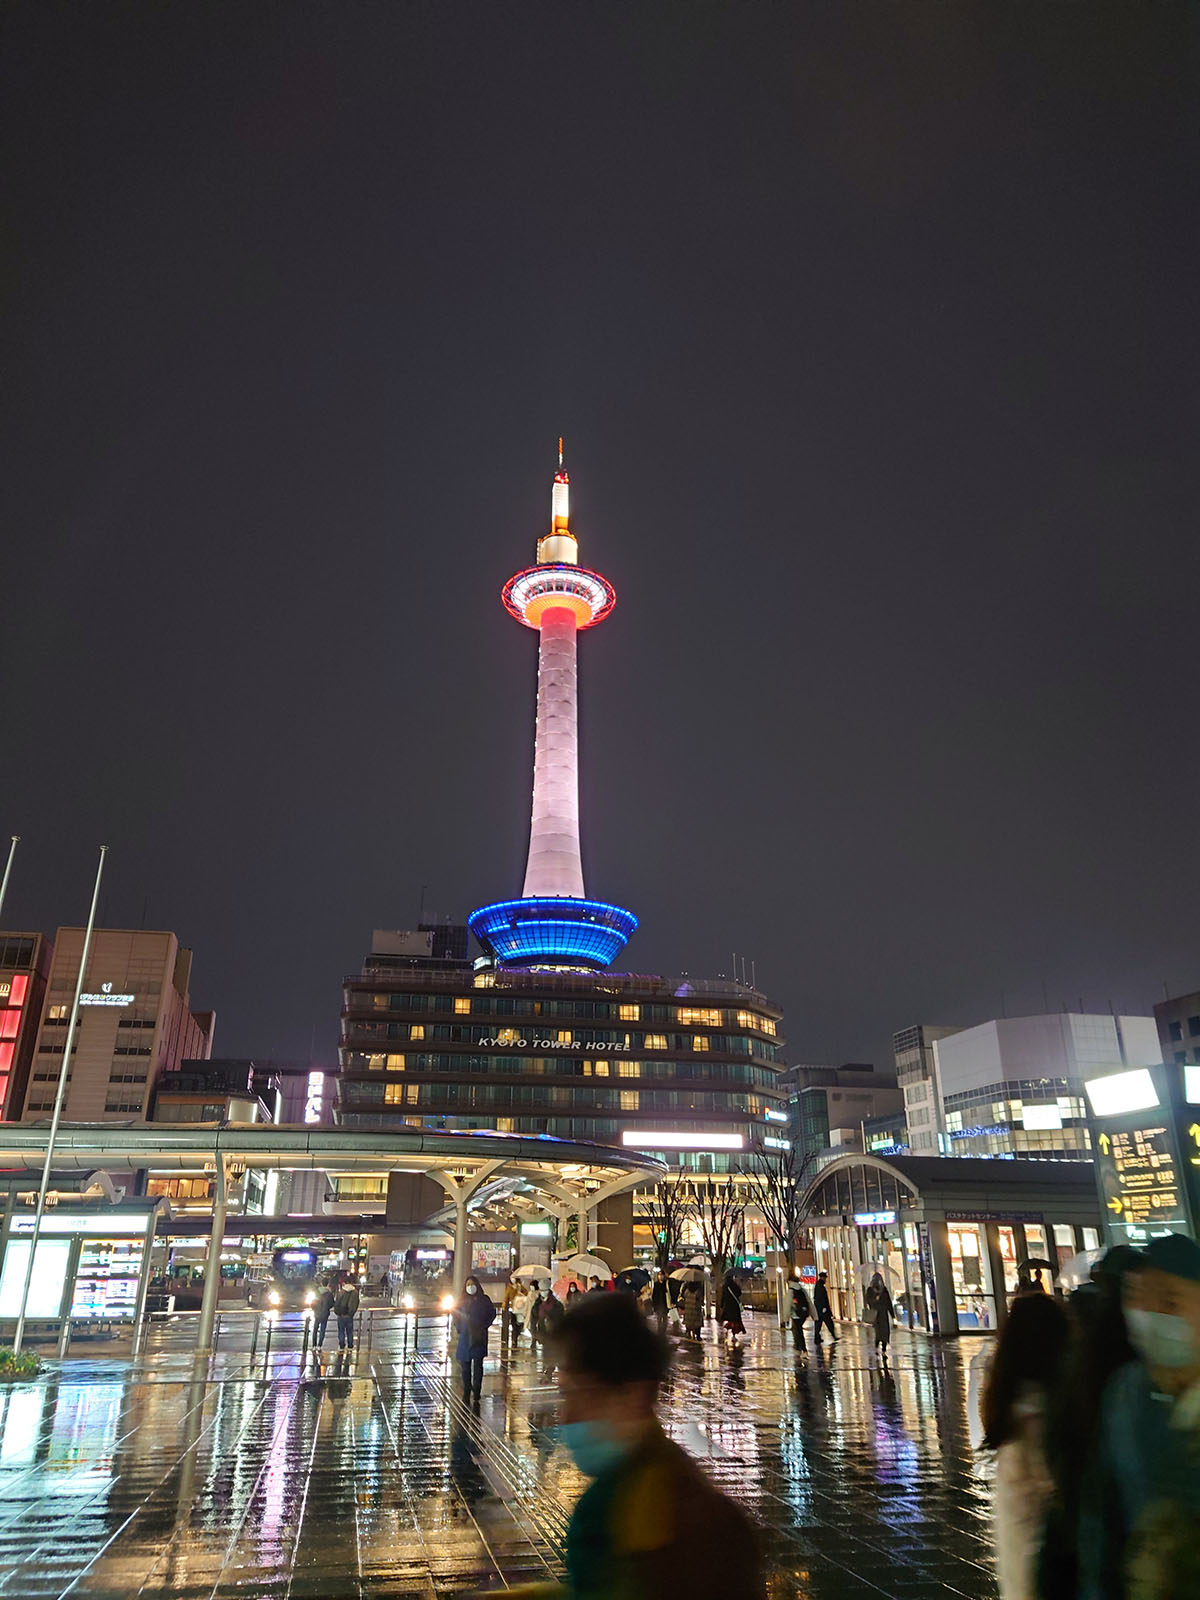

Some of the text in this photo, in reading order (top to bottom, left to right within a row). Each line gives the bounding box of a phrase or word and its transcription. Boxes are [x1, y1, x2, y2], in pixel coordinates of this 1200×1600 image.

[478, 1037, 631, 1052] KYOTO TOWER HOTEL
[946, 1211, 997, 1221] バスチケットセンター
